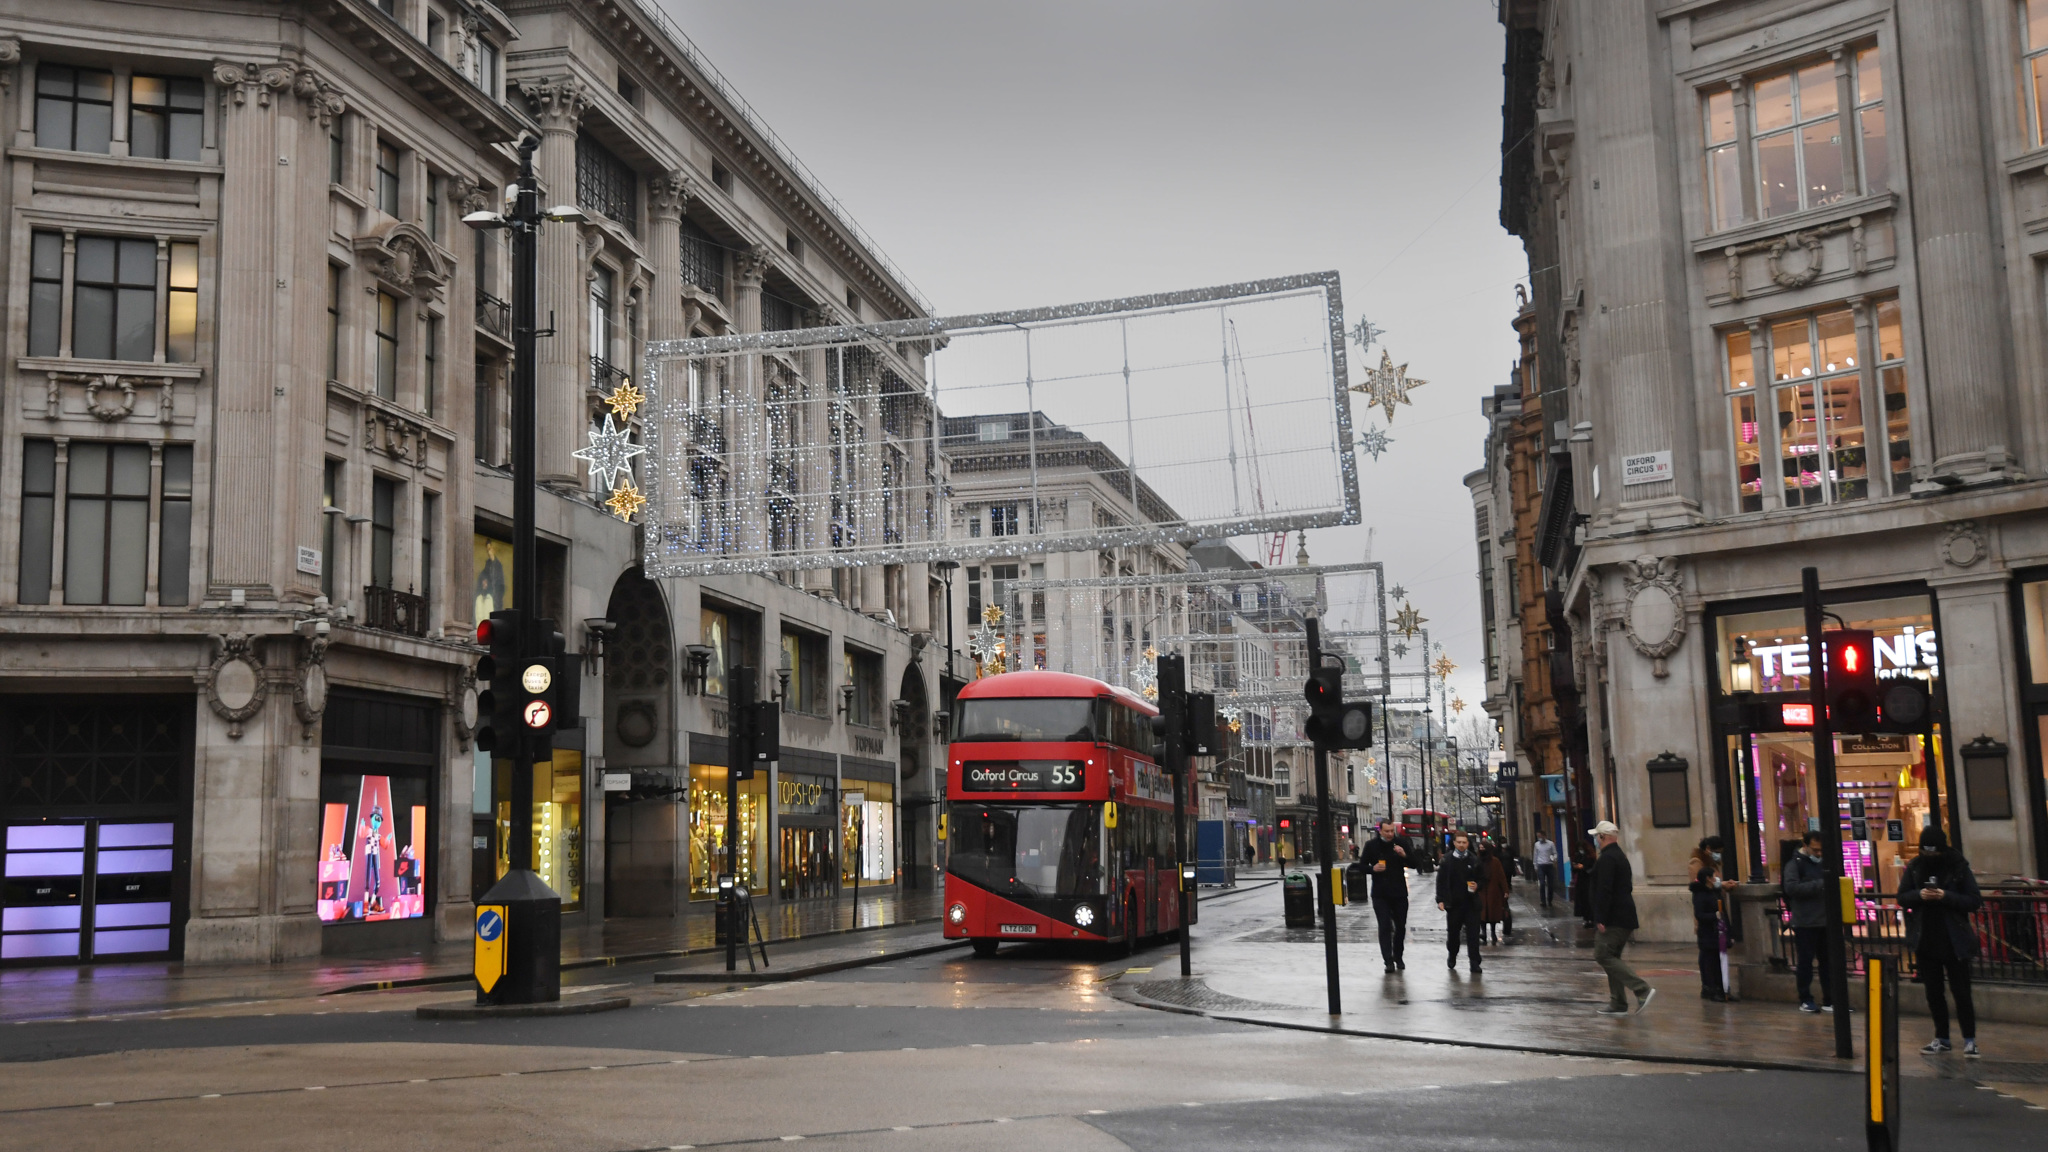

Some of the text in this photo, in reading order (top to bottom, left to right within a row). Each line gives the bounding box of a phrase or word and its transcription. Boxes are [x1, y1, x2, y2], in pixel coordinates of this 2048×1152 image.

[1626, 455, 1655, 467] OXFORD
[1626, 463, 1667, 475] CIRCUS W1
[855, 735, 884, 755] TOPMAN
[971, 765, 1076, 784] Oxford Circus 55
[1502, 766, 1516, 777] GAP
[777, 781, 822, 806] TOPSHOP
